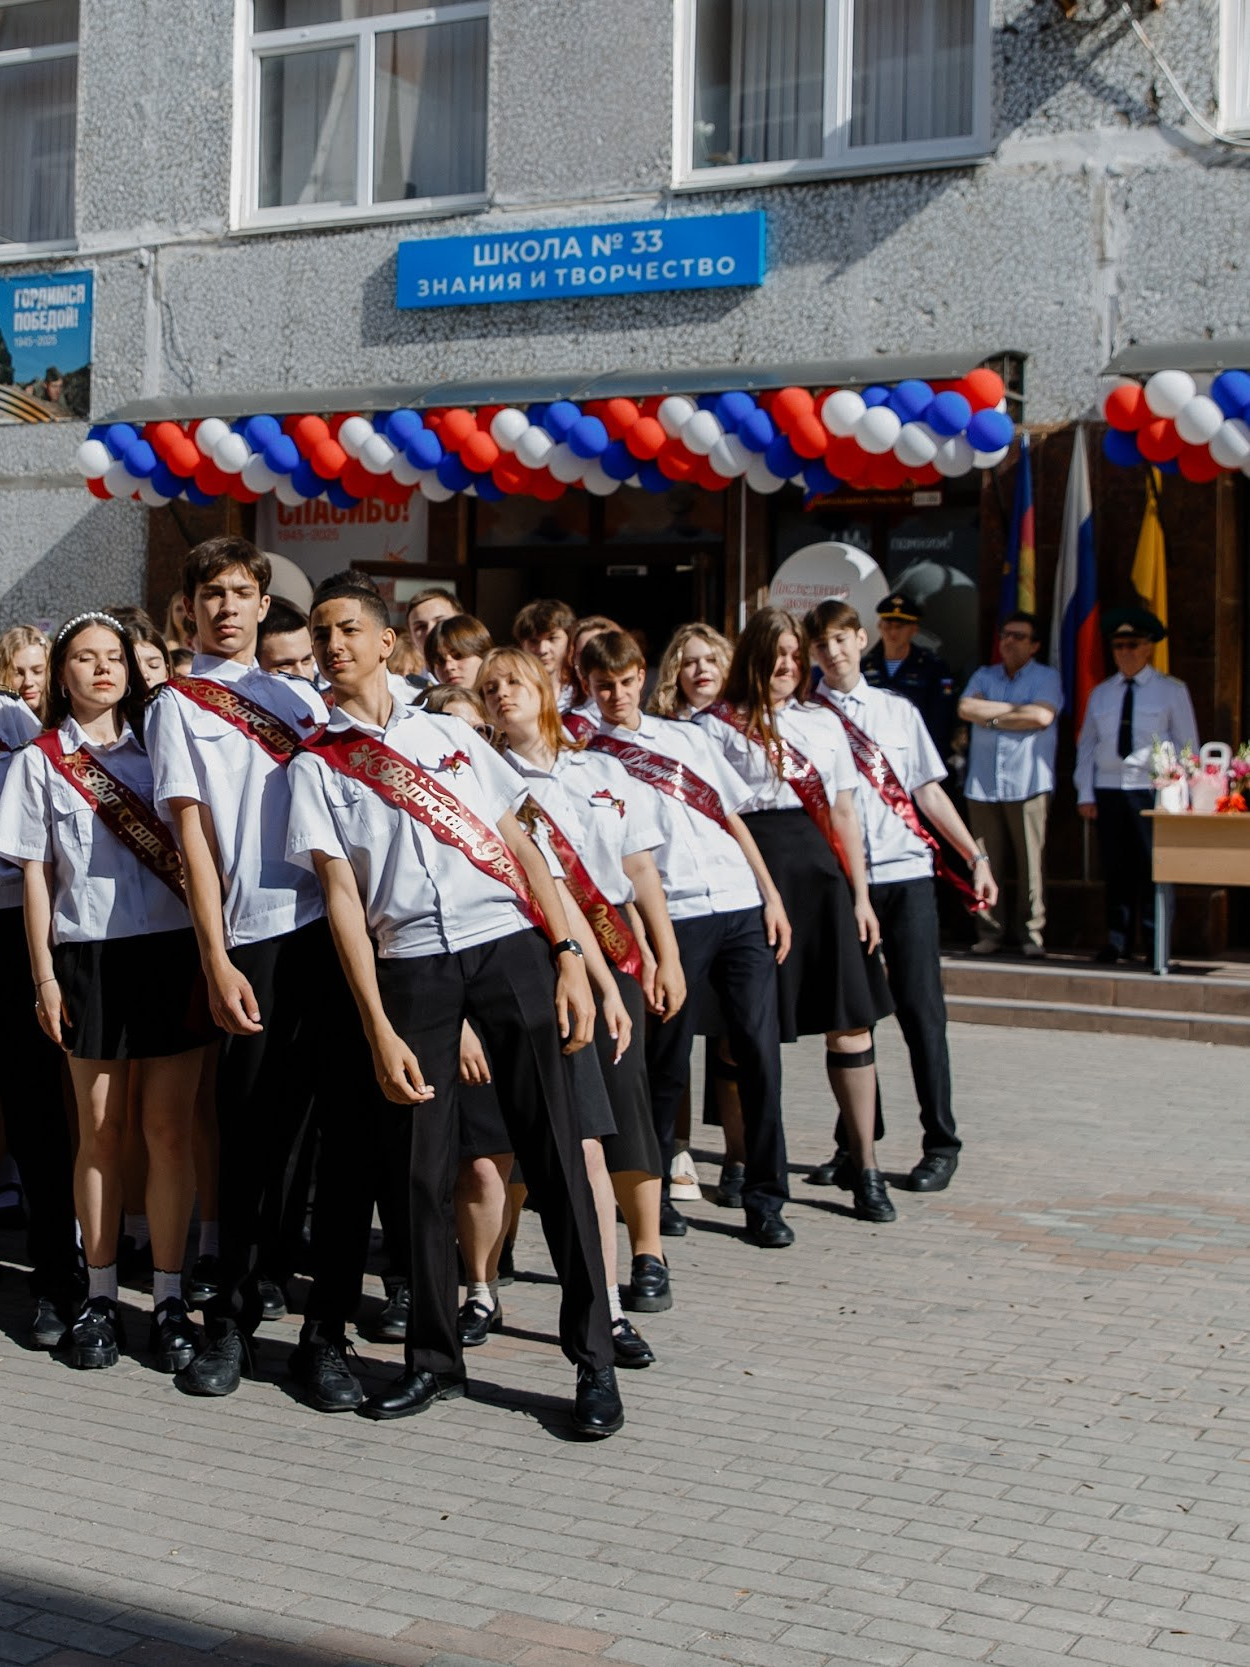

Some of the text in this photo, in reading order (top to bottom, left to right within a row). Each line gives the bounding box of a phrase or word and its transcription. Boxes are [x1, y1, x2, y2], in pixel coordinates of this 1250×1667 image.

[473, 229, 664, 267] ШКОЛА № 33
[417, 255, 737, 298] ЗНАНИЯ И ТВОРЧЕСТВО
[13, 283, 86, 310] ГОРДИМСЯ
[13, 305, 79, 333] ПОБЕДОЙ!
